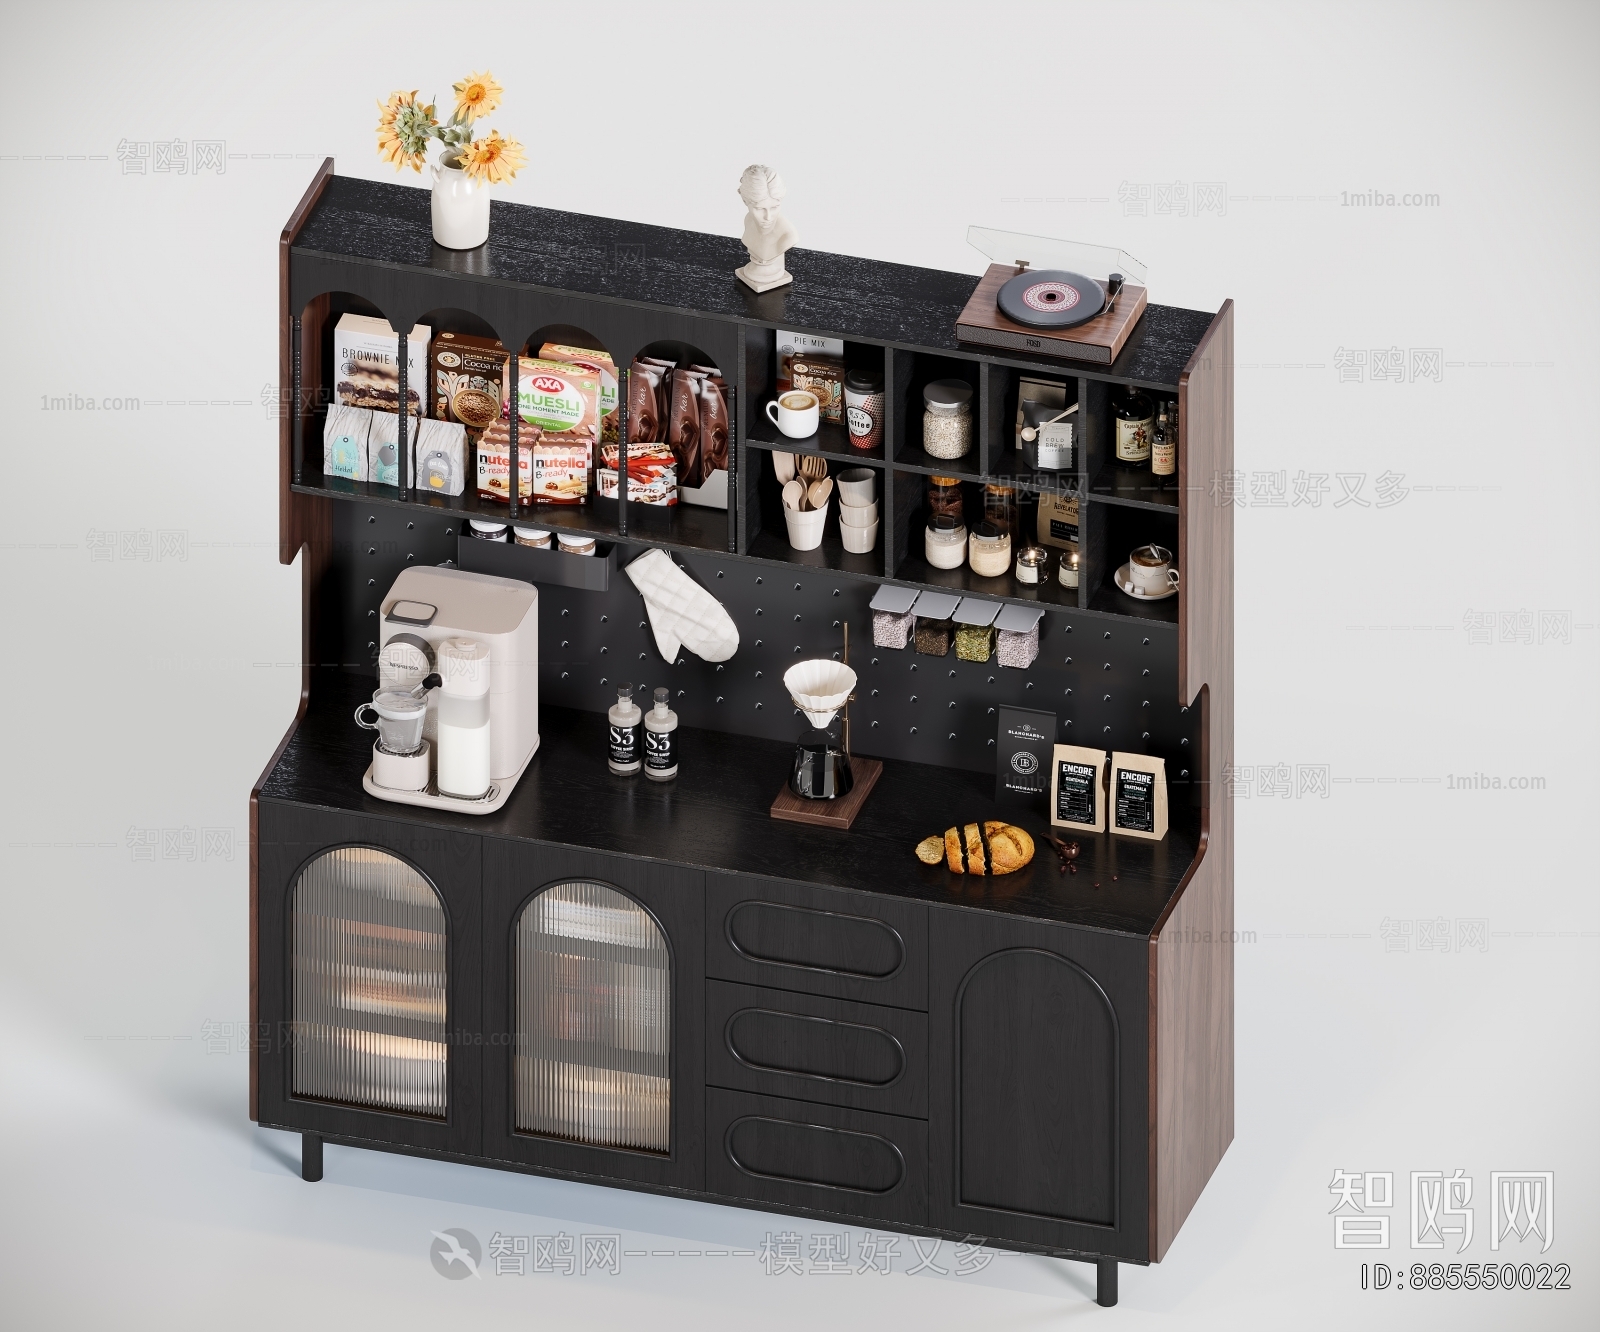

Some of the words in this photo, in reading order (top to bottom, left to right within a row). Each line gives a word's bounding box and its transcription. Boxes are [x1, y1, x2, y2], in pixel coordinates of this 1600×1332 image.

[794, 336, 807, 346] PIE
[811, 339, 826, 349] MIX
[342, 347, 390, 365] BROWNIE
[464, 359, 491, 370] Cocoa
[534, 376, 562, 391] AXA
[518, 392, 580, 412] MUESLI
[479, 454, 528, 469] nutea
[535, 457, 586, 469] nutella
[609, 726, 634, 745] S3
[645, 731, 671, 750] S3
[1062, 763, 1094, 777] ENCORE
[1120, 771, 1152, 784] ENCORE
